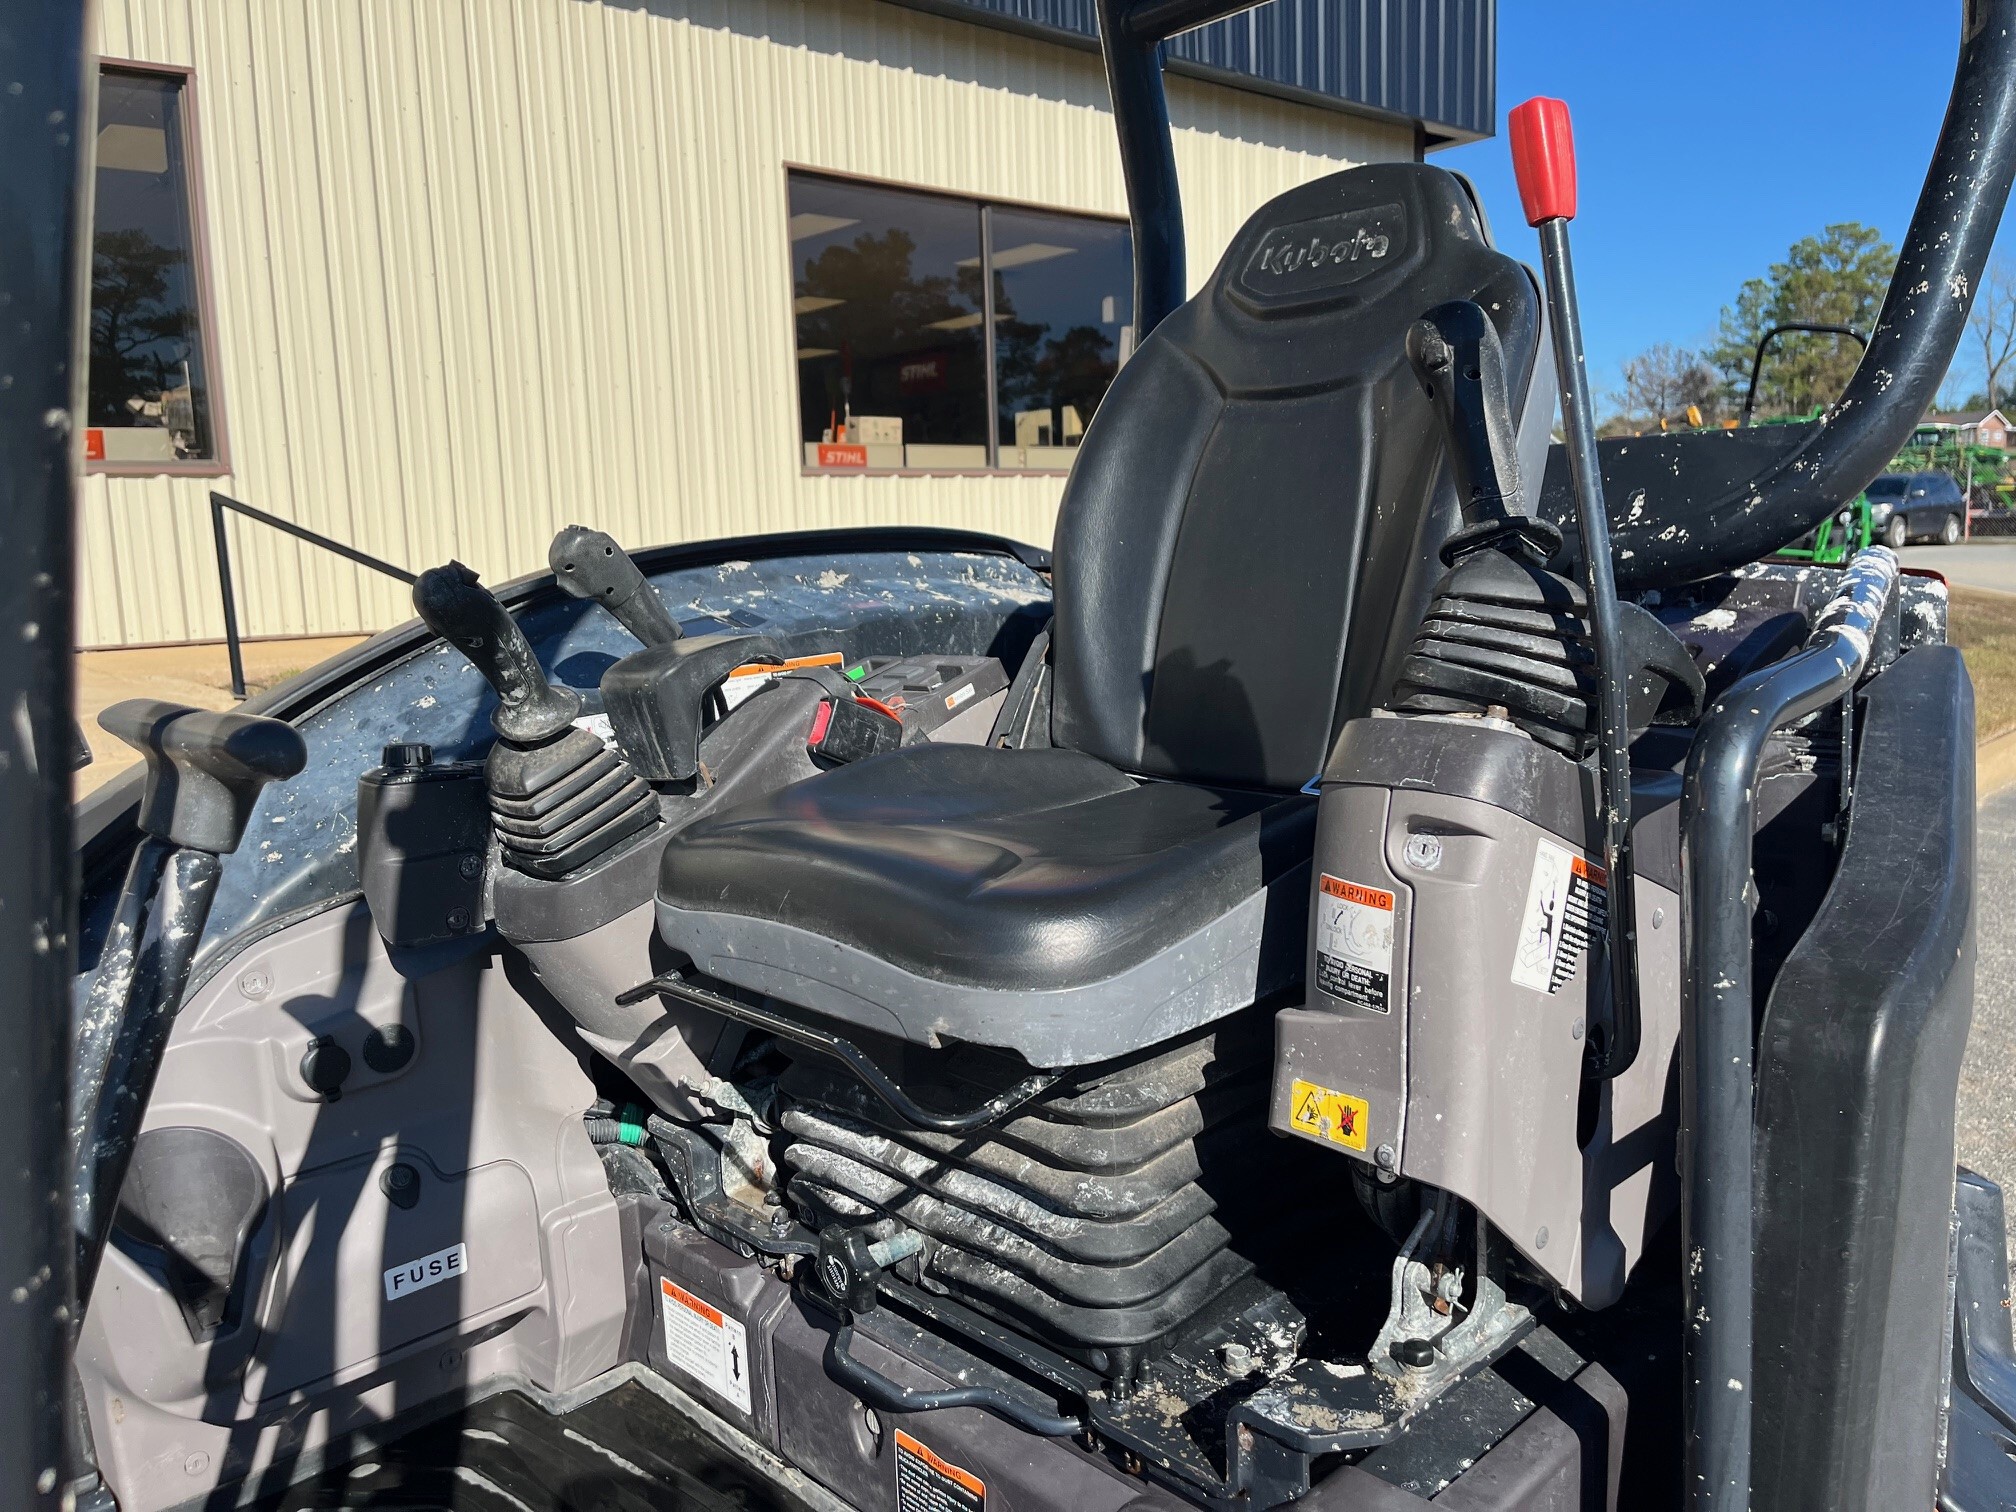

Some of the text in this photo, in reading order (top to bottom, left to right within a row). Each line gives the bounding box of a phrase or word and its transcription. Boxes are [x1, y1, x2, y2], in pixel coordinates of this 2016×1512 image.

[1261, 228, 1389, 274] Kubota
[825, 451, 865, 464] STIHL
[1332, 882, 1387, 907] WARNING
[1364, 986, 1384, 998] before
[393, 1253, 460, 1290] FUSE
[679, 1293, 711, 1318] WARNING
[928, 1455, 962, 1480] WARNING
